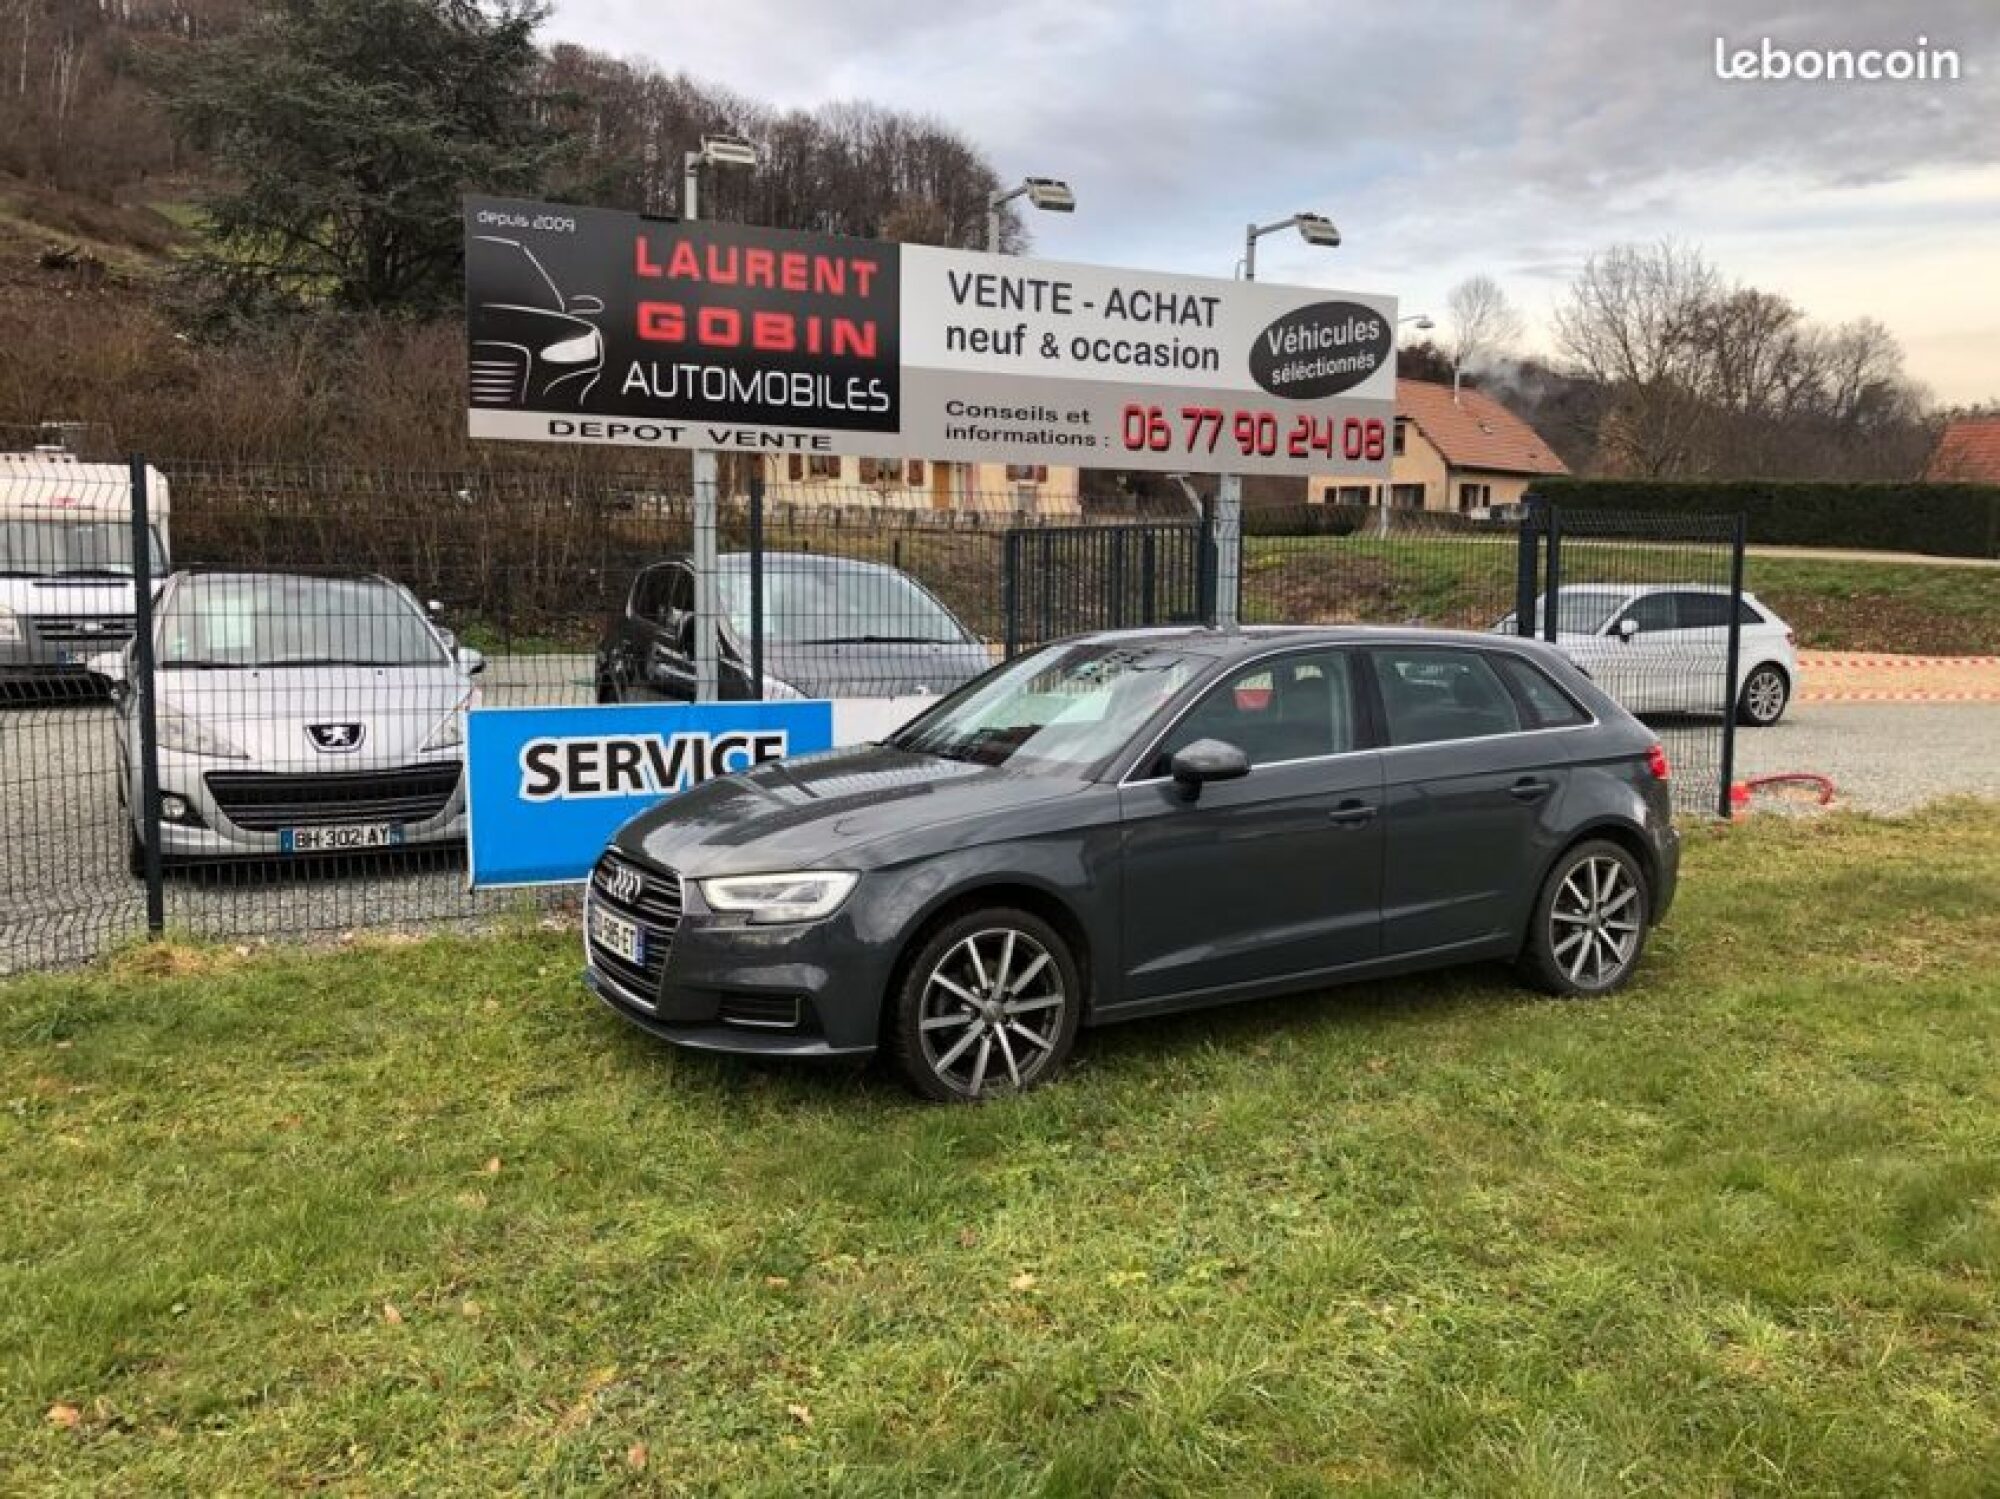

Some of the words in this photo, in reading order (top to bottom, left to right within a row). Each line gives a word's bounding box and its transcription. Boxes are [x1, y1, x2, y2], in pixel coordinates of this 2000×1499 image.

[477, 210, 530, 228] depuis
[533, 214, 576, 233] 2009
[635, 235, 877, 298] LAURENT
[948, 270, 1073, 315] VENTE
[1103, 287, 1221, 328] ACHAT
[636, 301, 877, 358] GOBIN
[945, 322, 1027, 356] neuf
[1040, 331, 1060, 359] &
[1070, 336, 1219, 371] occasion
[1266, 314, 1380, 356] Véhicules
[620, 359, 890, 412] AUTOMOBILES
[548, 420, 688, 442] DEPOT
[707, 428, 832, 452] VENTE
[944, 422, 1097, 447] informations
[945, 400, 1059, 423] Conseils
[1066, 408, 1092, 424] et
[1122, 403, 1172, 452] 06
[1180, 407, 1225, 454] 77
[1234, 410, 1278, 457] 90
[1288, 414, 1335, 460] 24
[1344, 417, 1386, 461] 08
